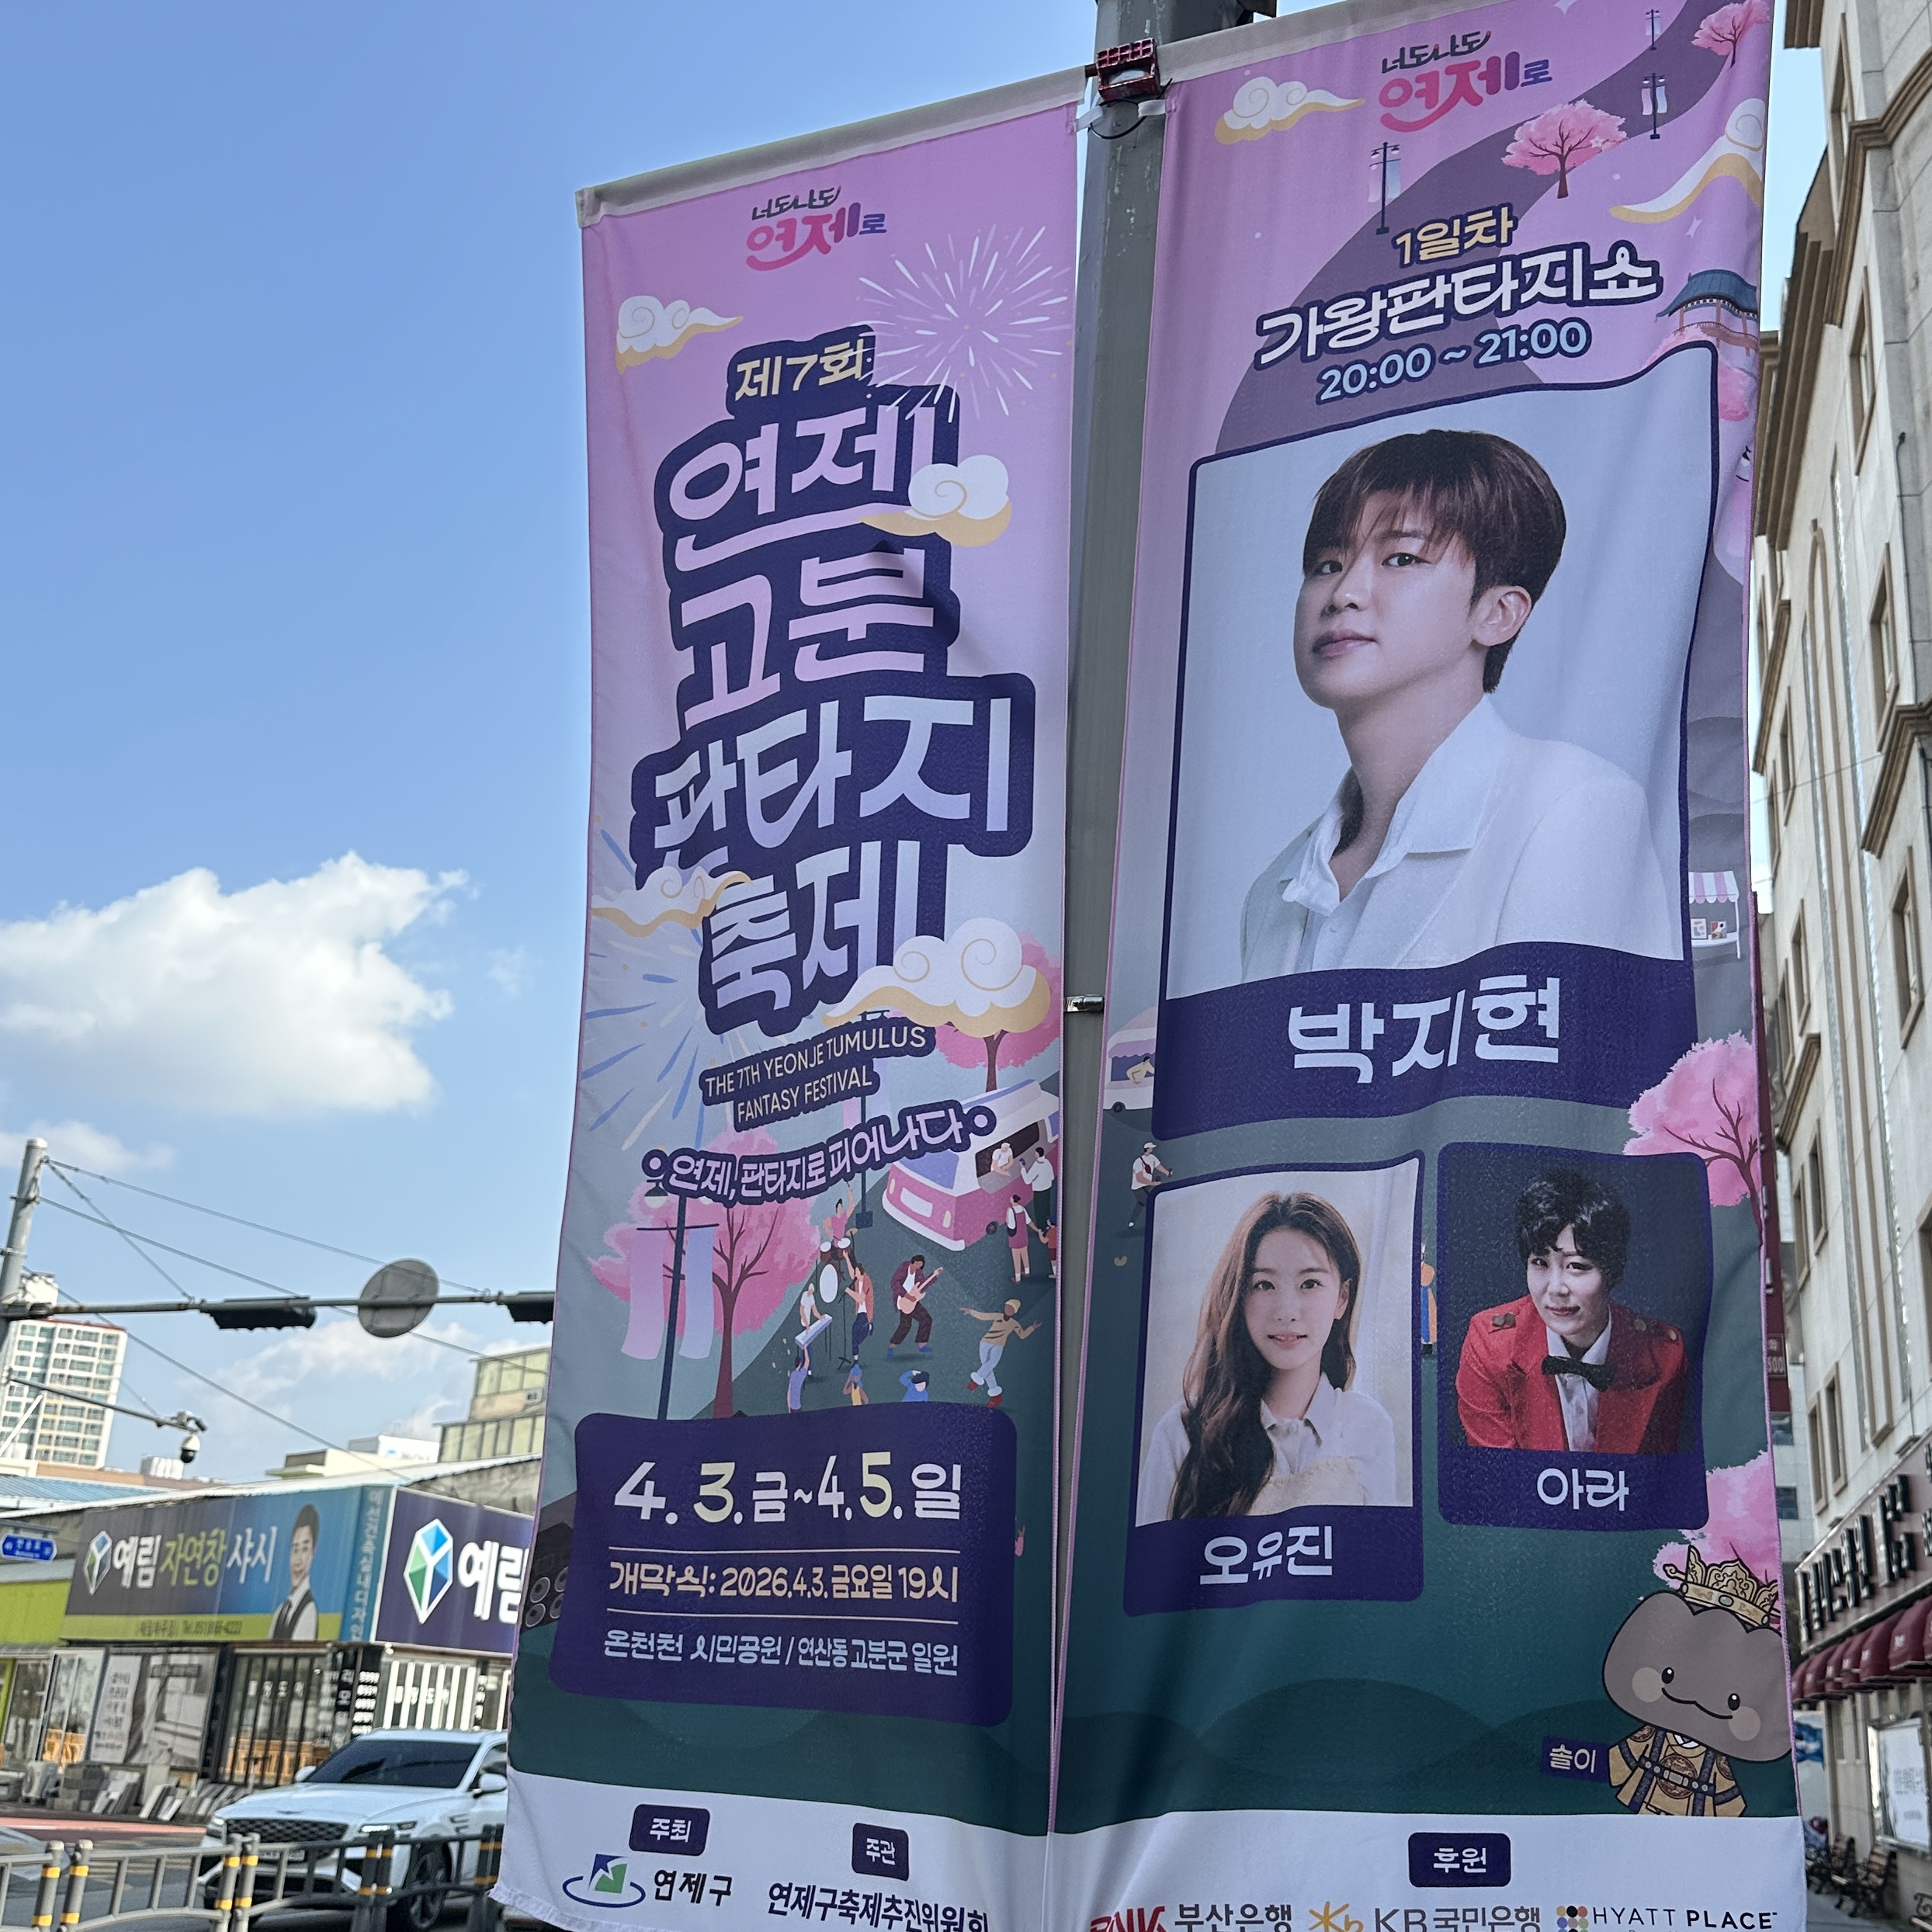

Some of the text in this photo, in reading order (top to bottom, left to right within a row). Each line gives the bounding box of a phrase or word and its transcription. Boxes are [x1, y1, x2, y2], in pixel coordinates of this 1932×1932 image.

[1379, 51, 1552, 133] 연제로
[746, 202, 887, 272] 연제로
[1396, 206, 1514, 265] 1일차
[1261, 247, 1657, 365] 가왕판타지쇼
[735, 338, 864, 401] 제7회
[1320, 352, 1431, 401] 20:00
[1479, 323, 1587, 364] 21:00
[669, 404, 935, 572] 연제
[682, 548, 934, 730] 고분
[654, 695, 1011, 870] 판타지
[710, 840, 921, 1011] 축제
[1289, 975, 1560, 1084] 박지현
[706, 1025, 927, 1098] THE 7TH YEONJE TUMULUS
[737, 1065, 873, 1124] FANTASY FESTIVAL
[672, 1108, 963, 1200] 연제, 판타지로 피어나다
[1537, 1468, 1629, 1511] 아라
[114, 1535, 161, 1589] 예림
[458, 1540, 529, 1624] 예림
[609, 1561, 716, 1598] 개막식:
[831, 1564, 892, 1599] 금요일
[898, 1566, 959, 1602] 19시
[1199, 1526, 1334, 1585] 오유진
[604, 1628, 684, 1662] 온천천
[690, 1634, 781, 1666] 시민공원
[912, 1642, 959, 1677] 일원
[649, 1817, 692, 1843] 주최
[865, 1837, 896, 1866] 주관
[1433, 1847, 1486, 1873] 후원
[654, 1869, 733, 1906] 연제구
[1593, 1906, 1774, 1930] HYATT PLACE
